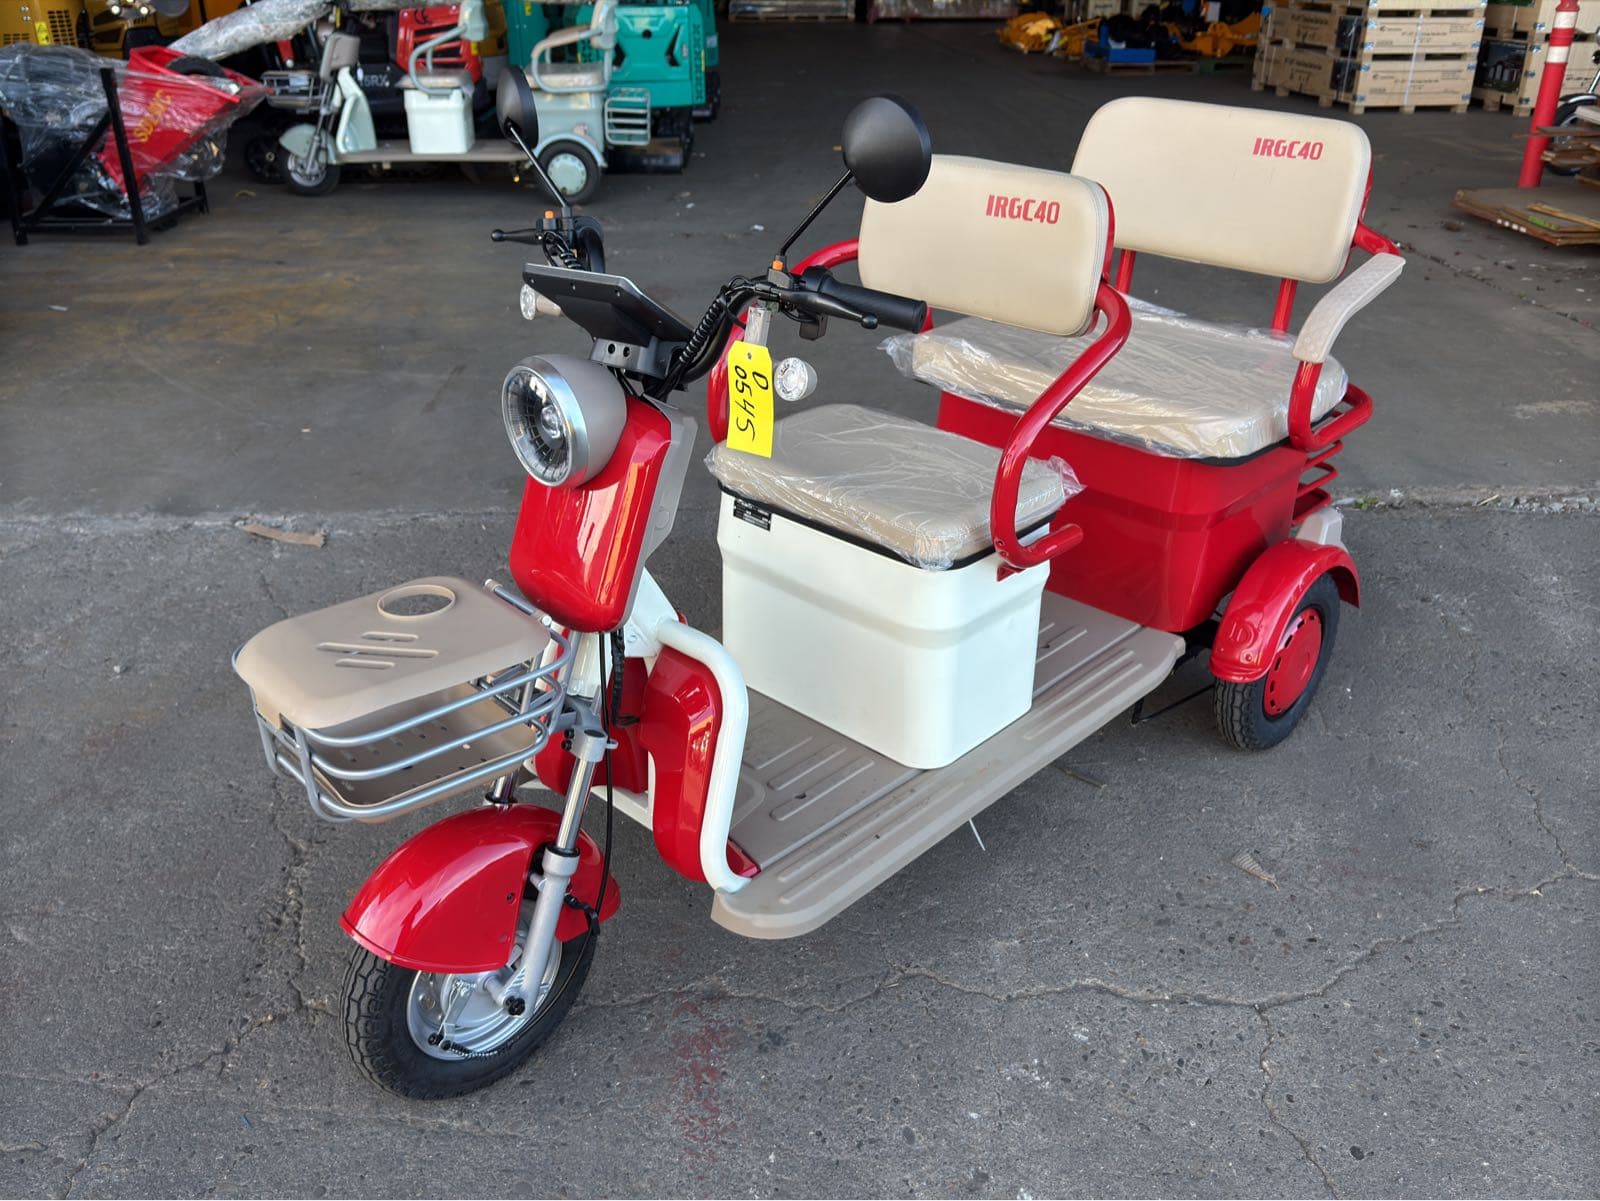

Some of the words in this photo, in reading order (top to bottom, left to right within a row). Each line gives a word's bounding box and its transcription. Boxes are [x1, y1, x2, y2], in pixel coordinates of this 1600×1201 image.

[1253, 138, 1323, 160] IRGC40
[986, 194, 1061, 224] IRGC40
[734, 365, 756, 442] 0545
